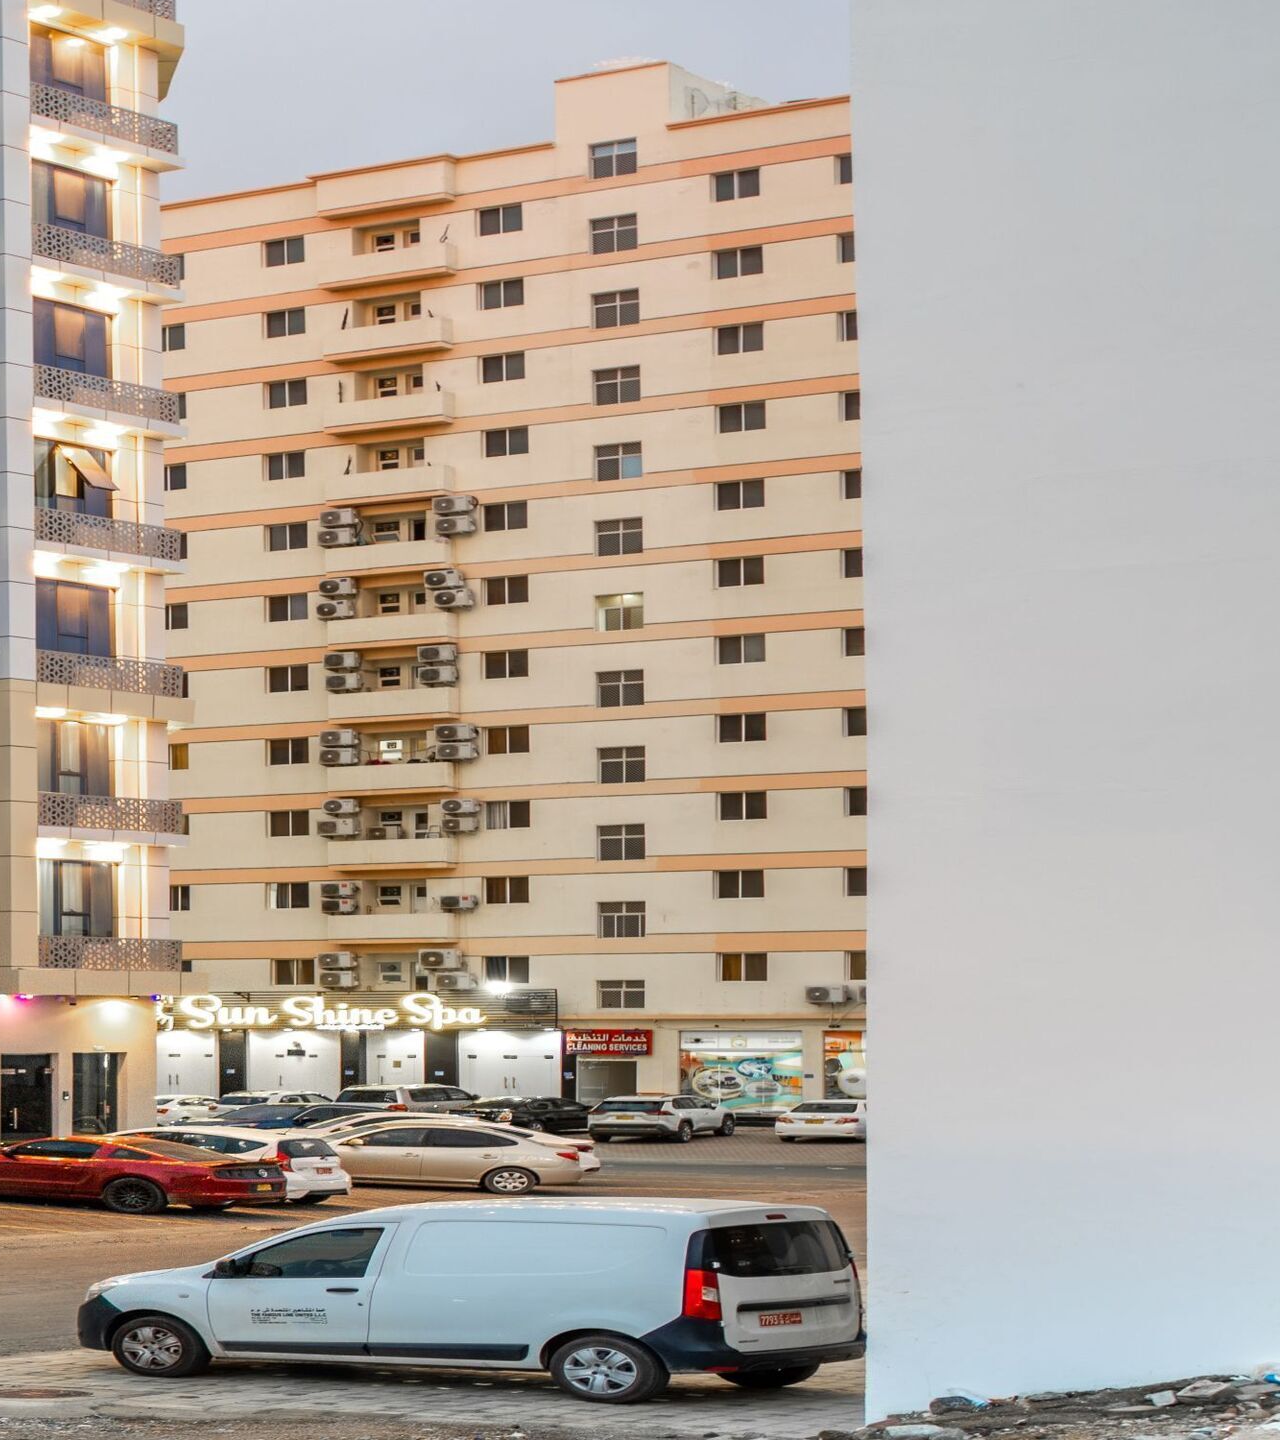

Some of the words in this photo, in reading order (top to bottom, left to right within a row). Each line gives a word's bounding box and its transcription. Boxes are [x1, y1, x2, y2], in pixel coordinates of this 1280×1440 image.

[179, 993, 278, 1029] Sun
[280, 995, 401, 1027] Shine
[401, 992, 487, 1031] Spa
[611, 1032, 647, 1043] خدمات
[566, 1043, 608, 1052] CLEANING
[609, 1043, 648, 1052] SERVICES
